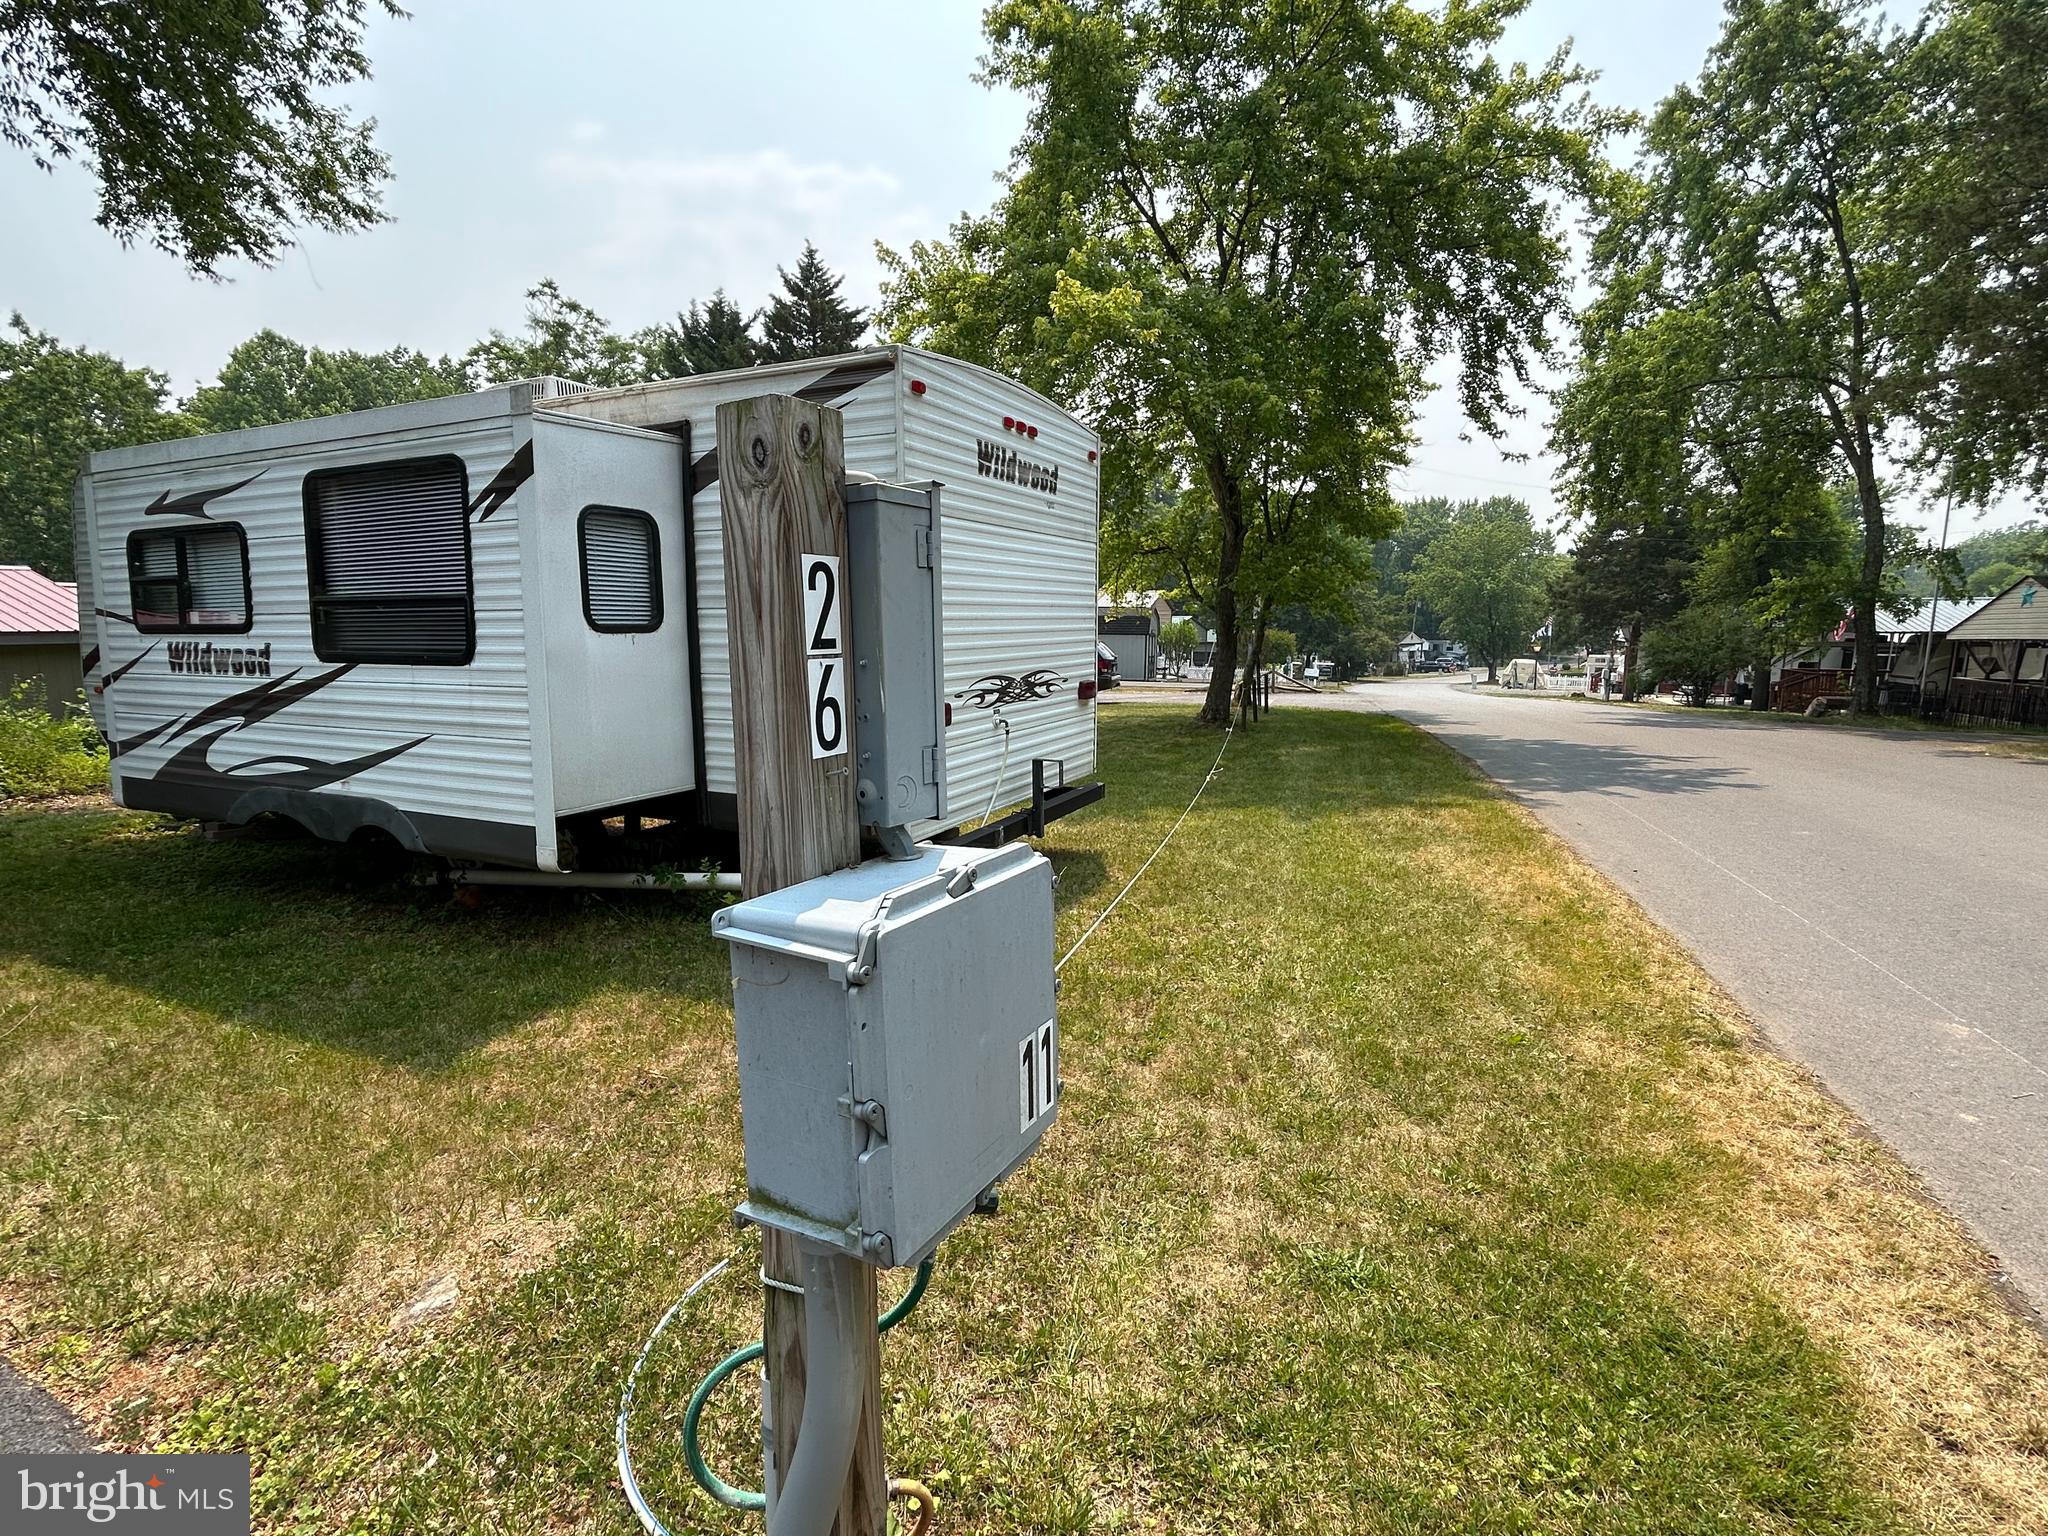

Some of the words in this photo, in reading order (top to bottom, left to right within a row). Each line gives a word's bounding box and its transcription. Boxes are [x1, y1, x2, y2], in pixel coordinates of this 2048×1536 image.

[976, 439, 1059, 495] Wildwood
[167, 641, 271, 676] Wildwood
[1023, 1026, 1051, 1121] 11
